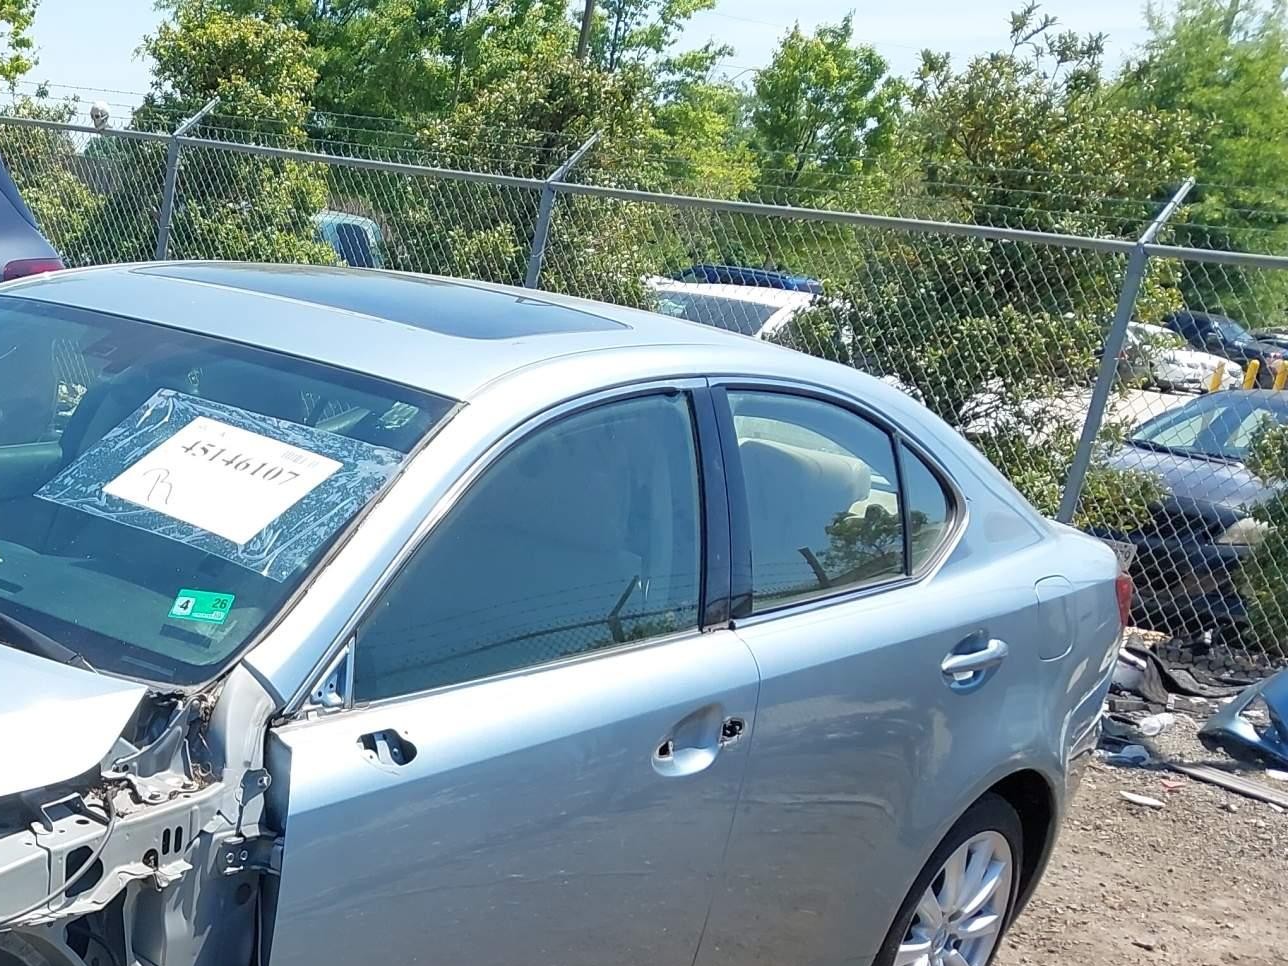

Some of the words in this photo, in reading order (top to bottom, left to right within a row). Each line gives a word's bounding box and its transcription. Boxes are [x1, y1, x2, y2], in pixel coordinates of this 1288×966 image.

[181, 440, 300, 486] 45146107
[179, 599, 191, 611] 4
[212, 597, 229, 610] 26
